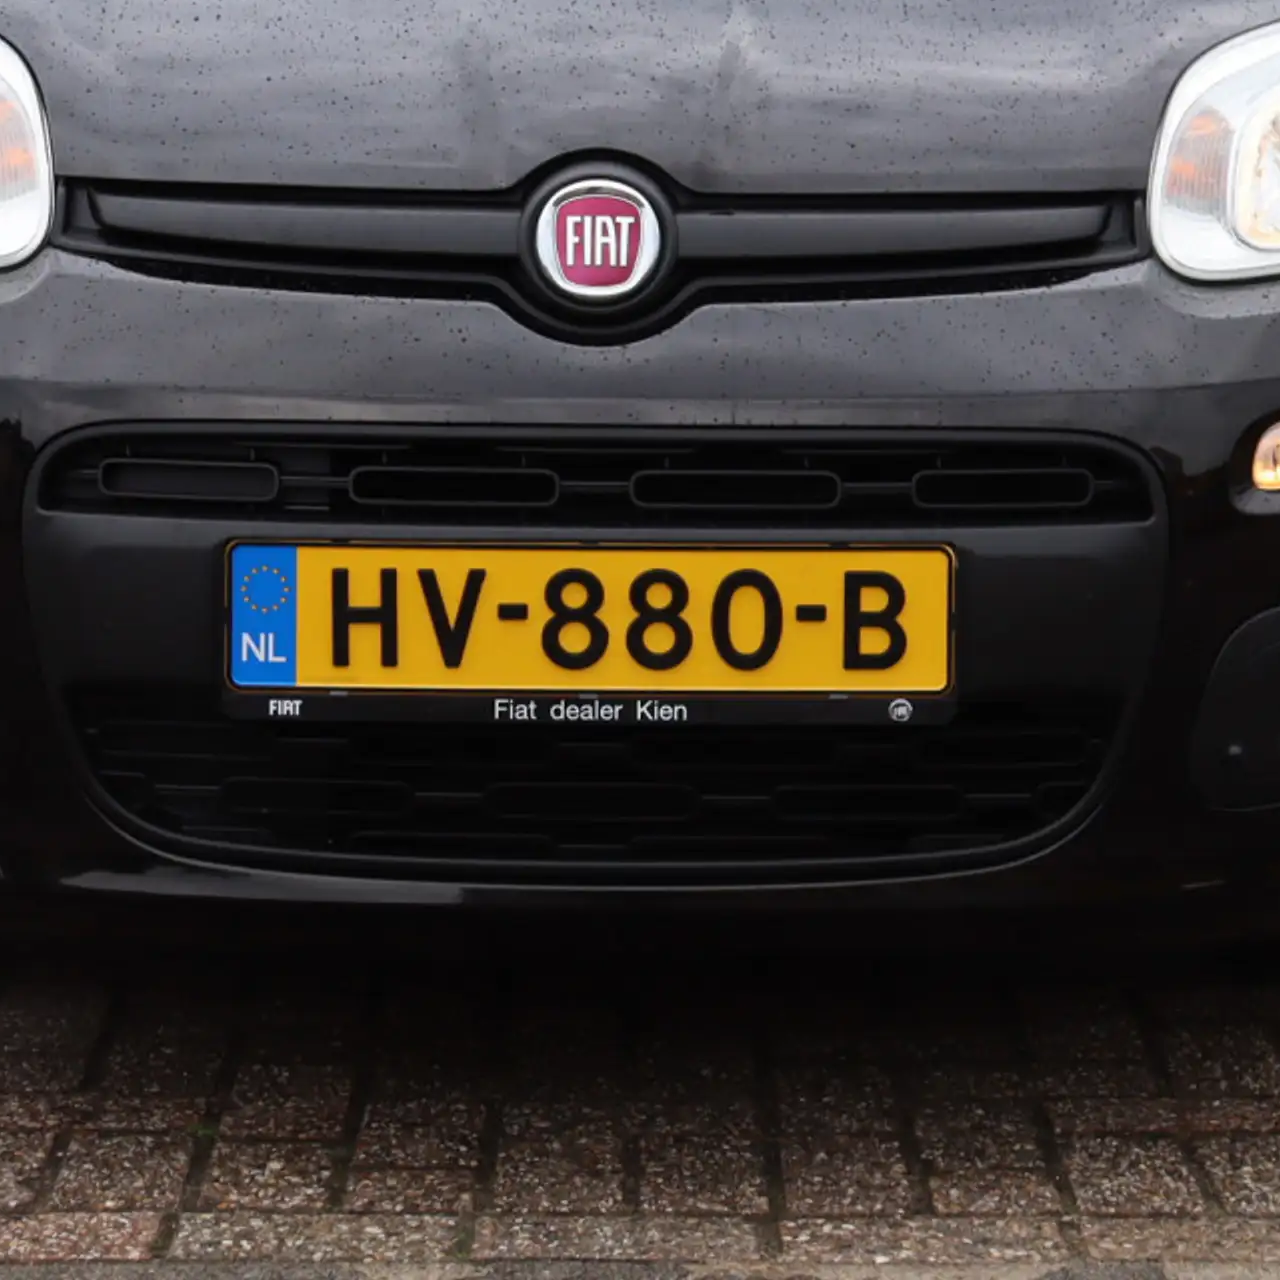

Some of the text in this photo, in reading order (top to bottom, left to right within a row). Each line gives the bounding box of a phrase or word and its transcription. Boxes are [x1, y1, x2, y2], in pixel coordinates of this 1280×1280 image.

[566, 215, 635, 267] FIAT
[330, 567, 908, 671] HV-880-B
[241, 632, 287, 663] NL
[268, 699, 303, 716] FIAT
[494, 698, 687, 721] Fiat dealer Kien
